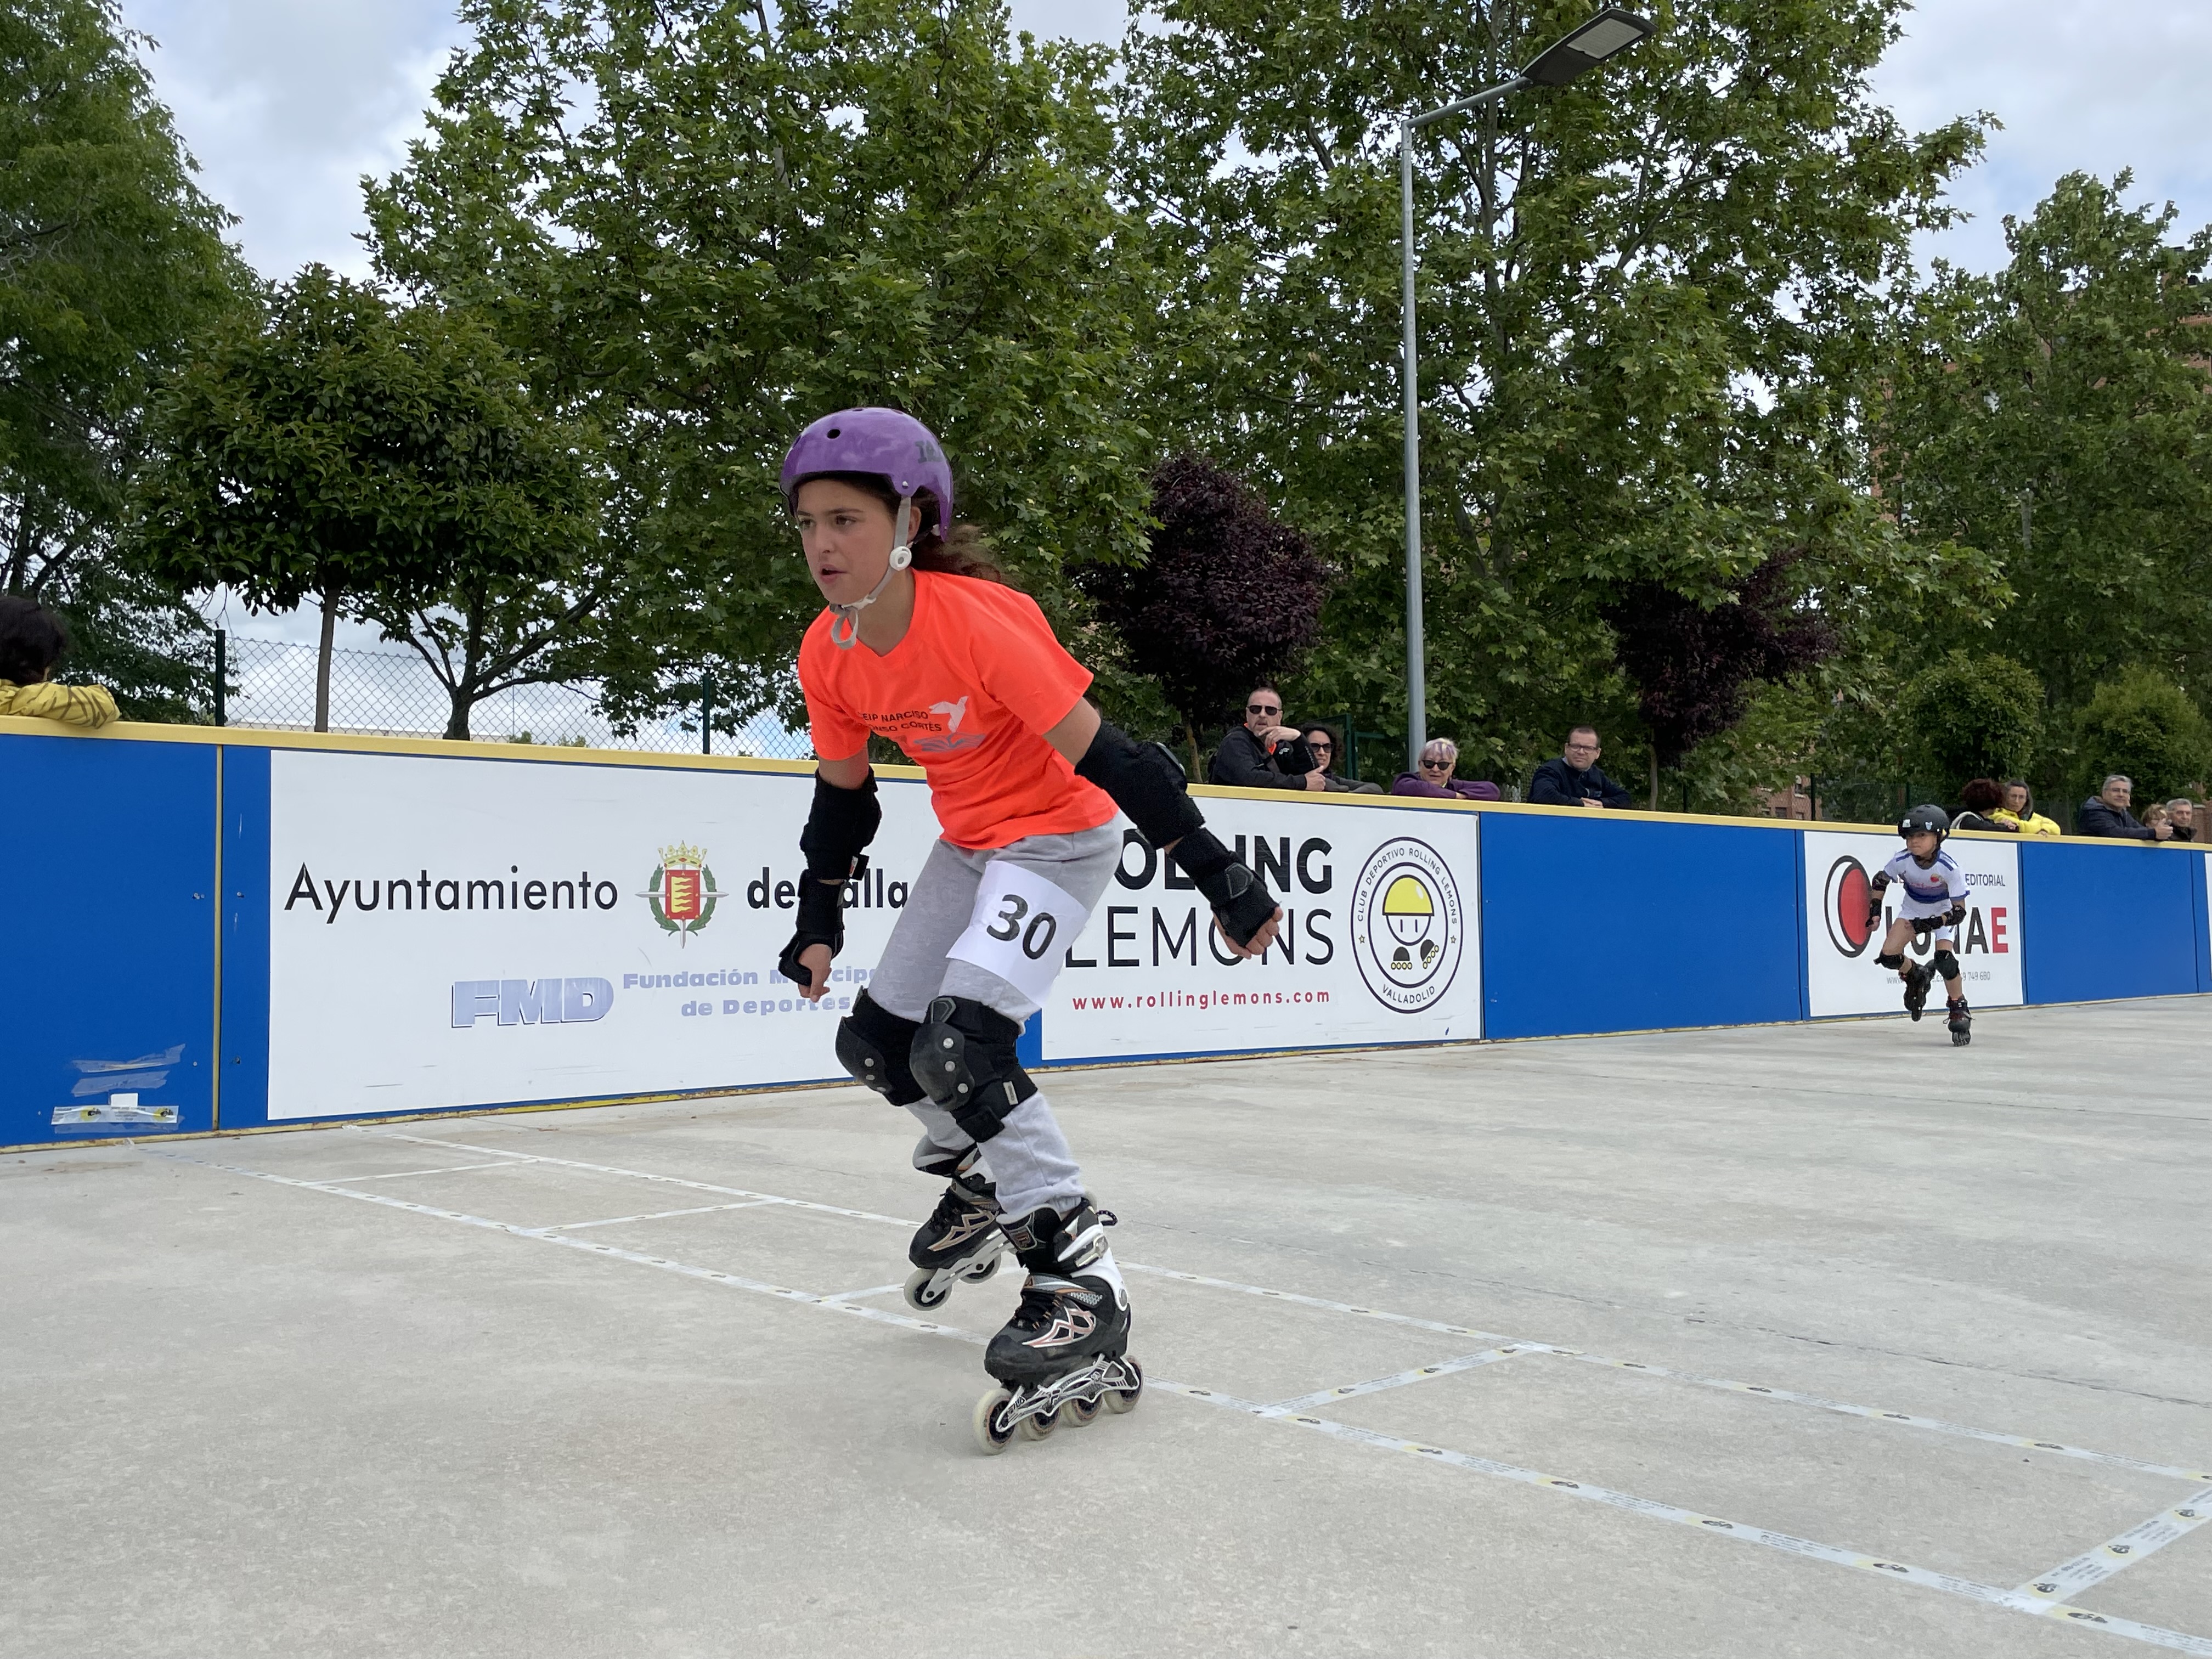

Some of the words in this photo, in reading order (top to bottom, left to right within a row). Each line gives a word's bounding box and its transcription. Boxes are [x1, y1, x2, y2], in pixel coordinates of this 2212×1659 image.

[860, 712, 878, 721] EIP
[882, 710, 928, 722] NARCISO
[1357, 890, 1368, 922] CLUB
[1365, 848, 1405, 886] DEPORTIVO
[1409, 848, 1441, 875] ROLLING
[1441, 877, 1458, 924] LEMONS
[1965, 873, 2006, 887] EDITORIAL
[284, 861, 618, 924] Ayuntamiento
[748, 867, 795, 909] de
[986, 894, 1057, 960] 30
[623, 969, 758, 989] Fundación
[452, 977, 614, 1029] FMD
[1072, 990, 1330, 1010] www.rollinglemons.com
[1382, 984, 1435, 1004] VALLADOLID
[681, 1001, 713, 1017] de
[723, 996, 850, 1016] Deportes
